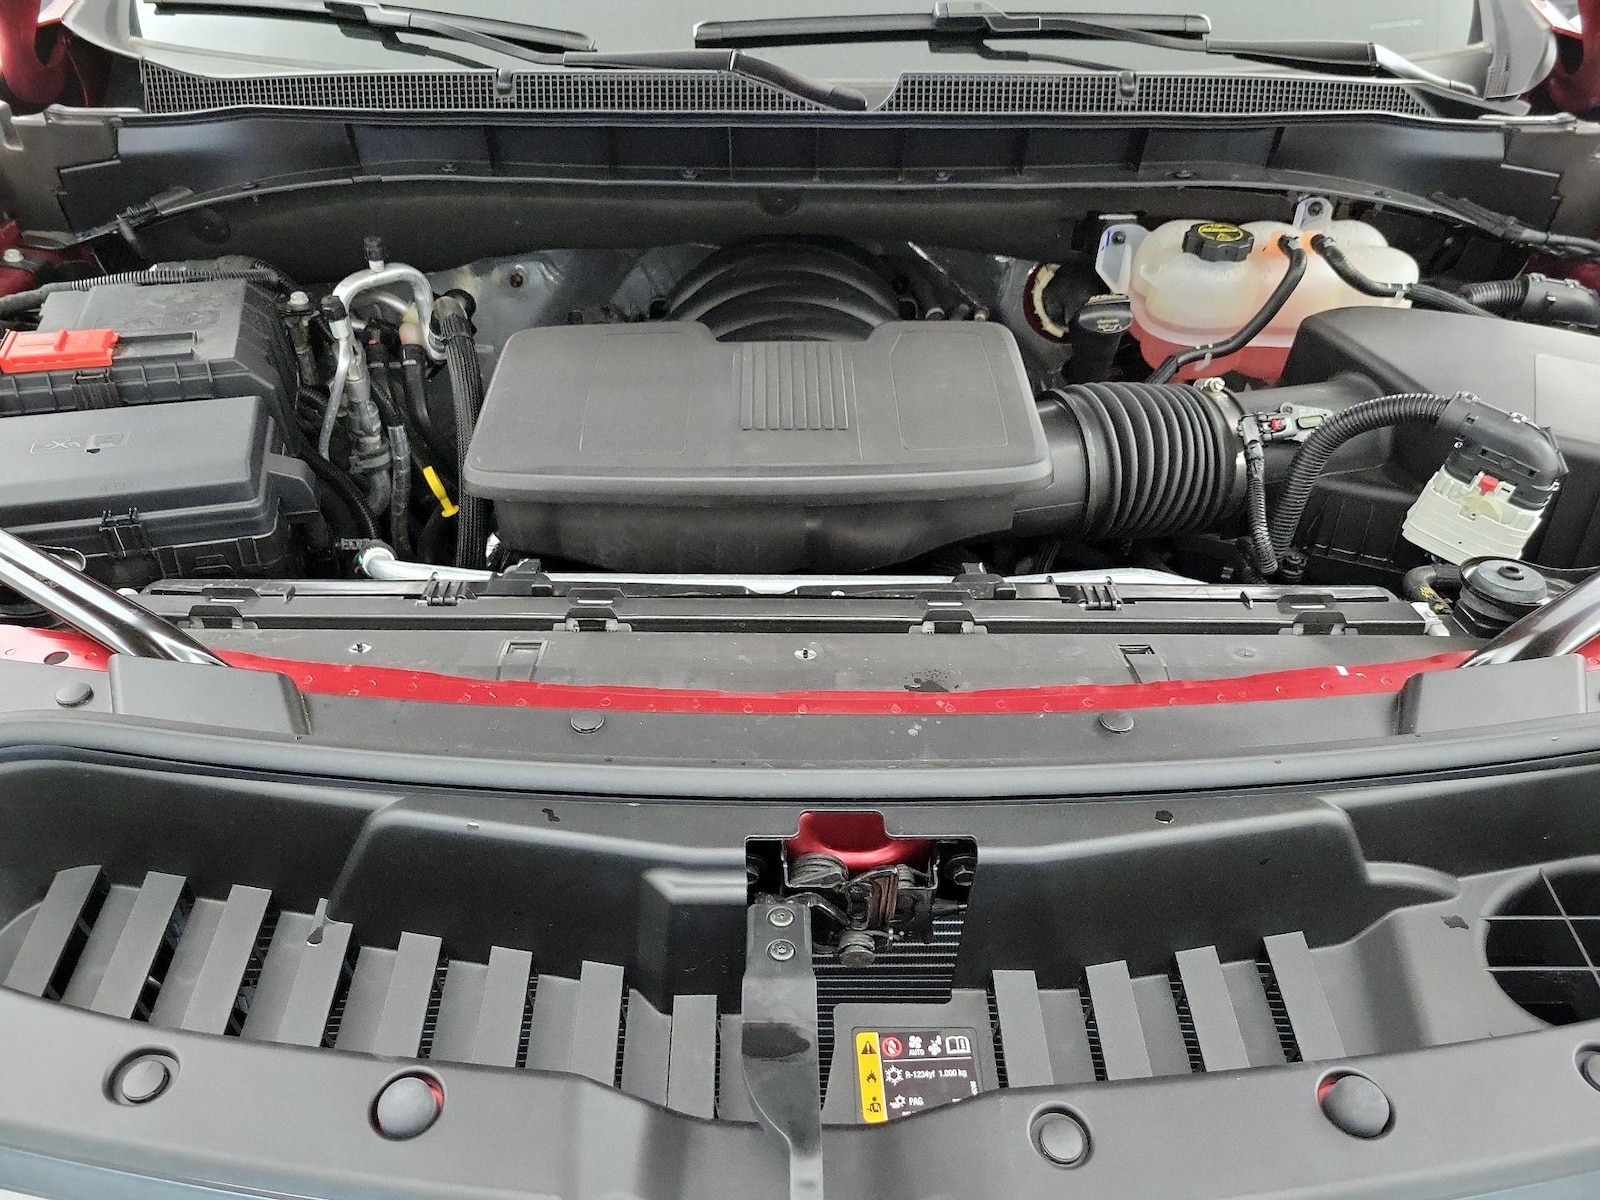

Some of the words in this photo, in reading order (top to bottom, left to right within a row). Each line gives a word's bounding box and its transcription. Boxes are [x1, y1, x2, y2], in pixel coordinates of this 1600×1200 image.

[905, 1070, 936, 1080] R-1234yf
[938, 1069, 957, 1078] 1.000
[958, 1068, 968, 1078] kg
[908, 1096, 924, 1106] PAG
